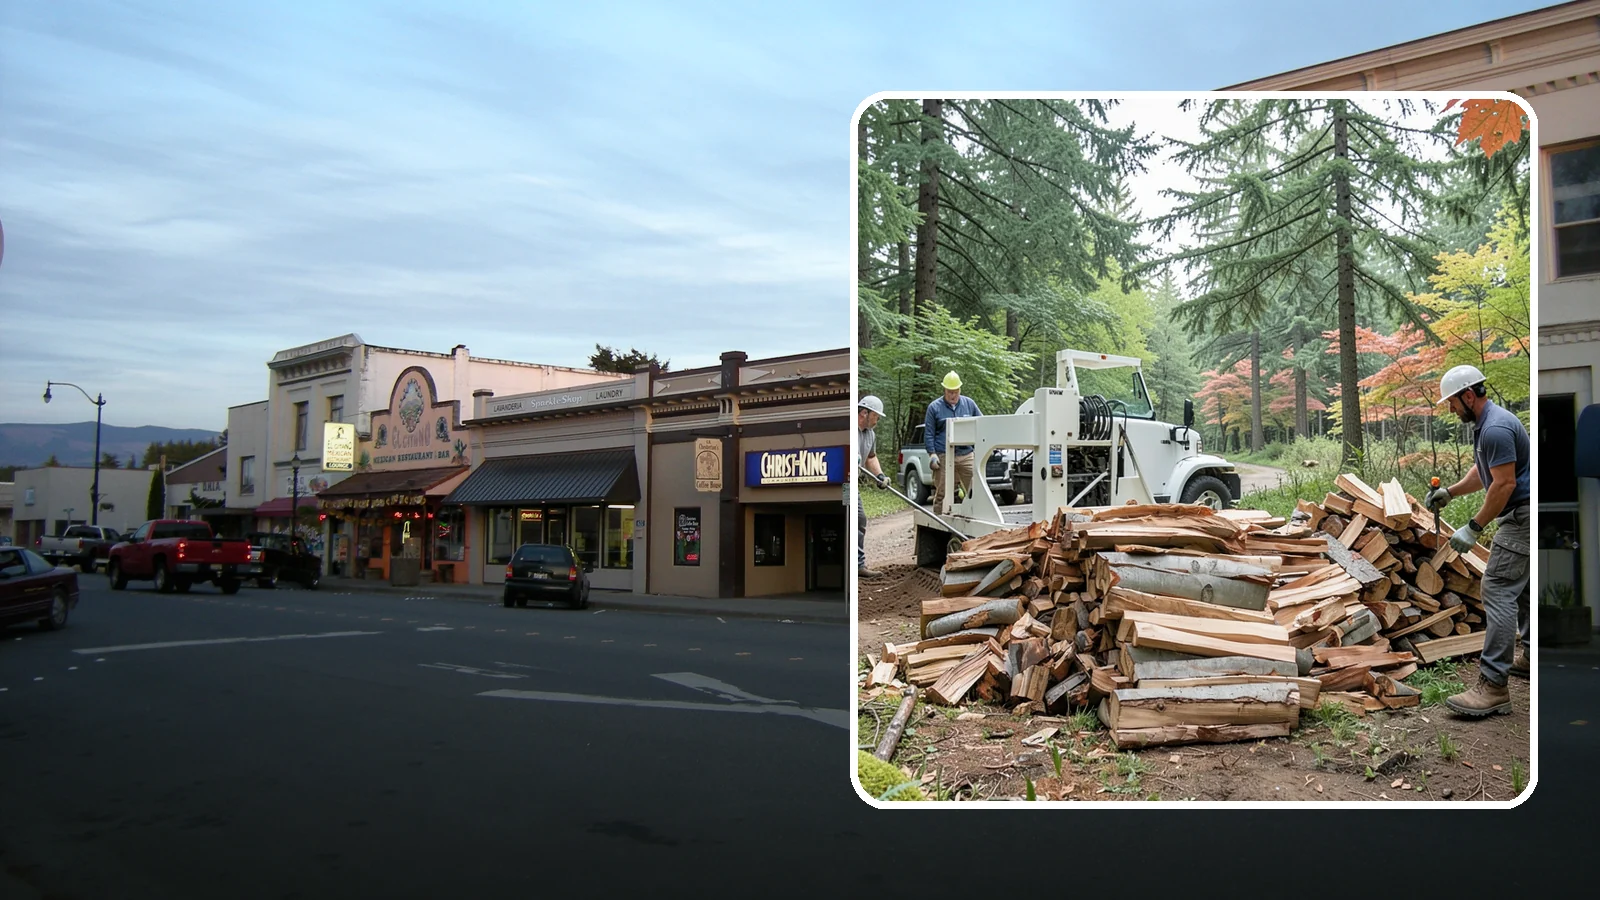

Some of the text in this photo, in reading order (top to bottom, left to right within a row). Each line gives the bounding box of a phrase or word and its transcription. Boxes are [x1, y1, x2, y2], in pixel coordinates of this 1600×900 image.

[595, 389, 623, 400] LAUNDRY
[493, 402, 522, 412] LAVANDERIA
[373, 455, 396, 464] MEXICAN
[397, 451, 433, 462] RESTAURANT
[437, 450, 450, 459] BAR
[761, 450, 827, 478] CHRIST KING
[696, 480, 709, 489] Coffee
